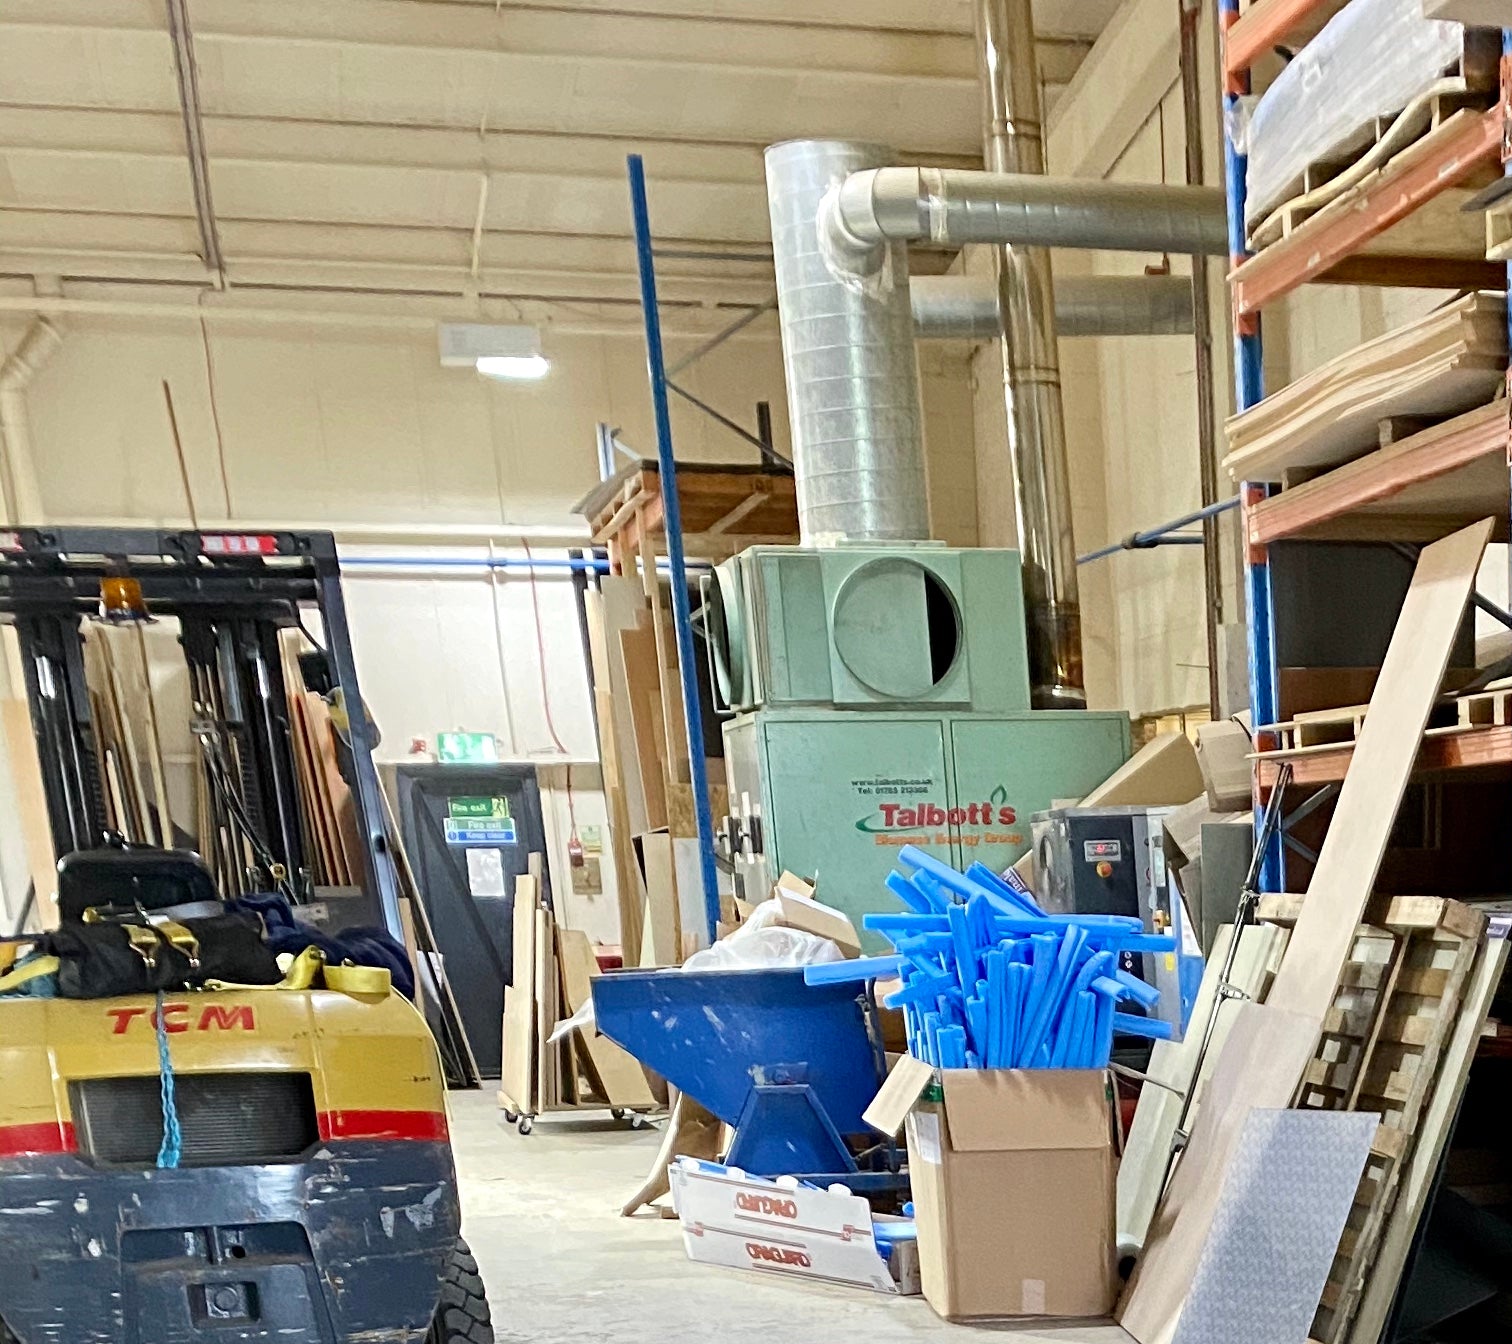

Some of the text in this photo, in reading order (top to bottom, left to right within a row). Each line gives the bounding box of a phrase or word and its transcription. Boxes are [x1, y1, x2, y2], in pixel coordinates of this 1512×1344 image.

[452, 803, 487, 812] Fire exit
[879, 800, 1017, 827] Talbott's
[467, 820, 485, 830] Fire
[106, 1003, 255, 1035] TCM
